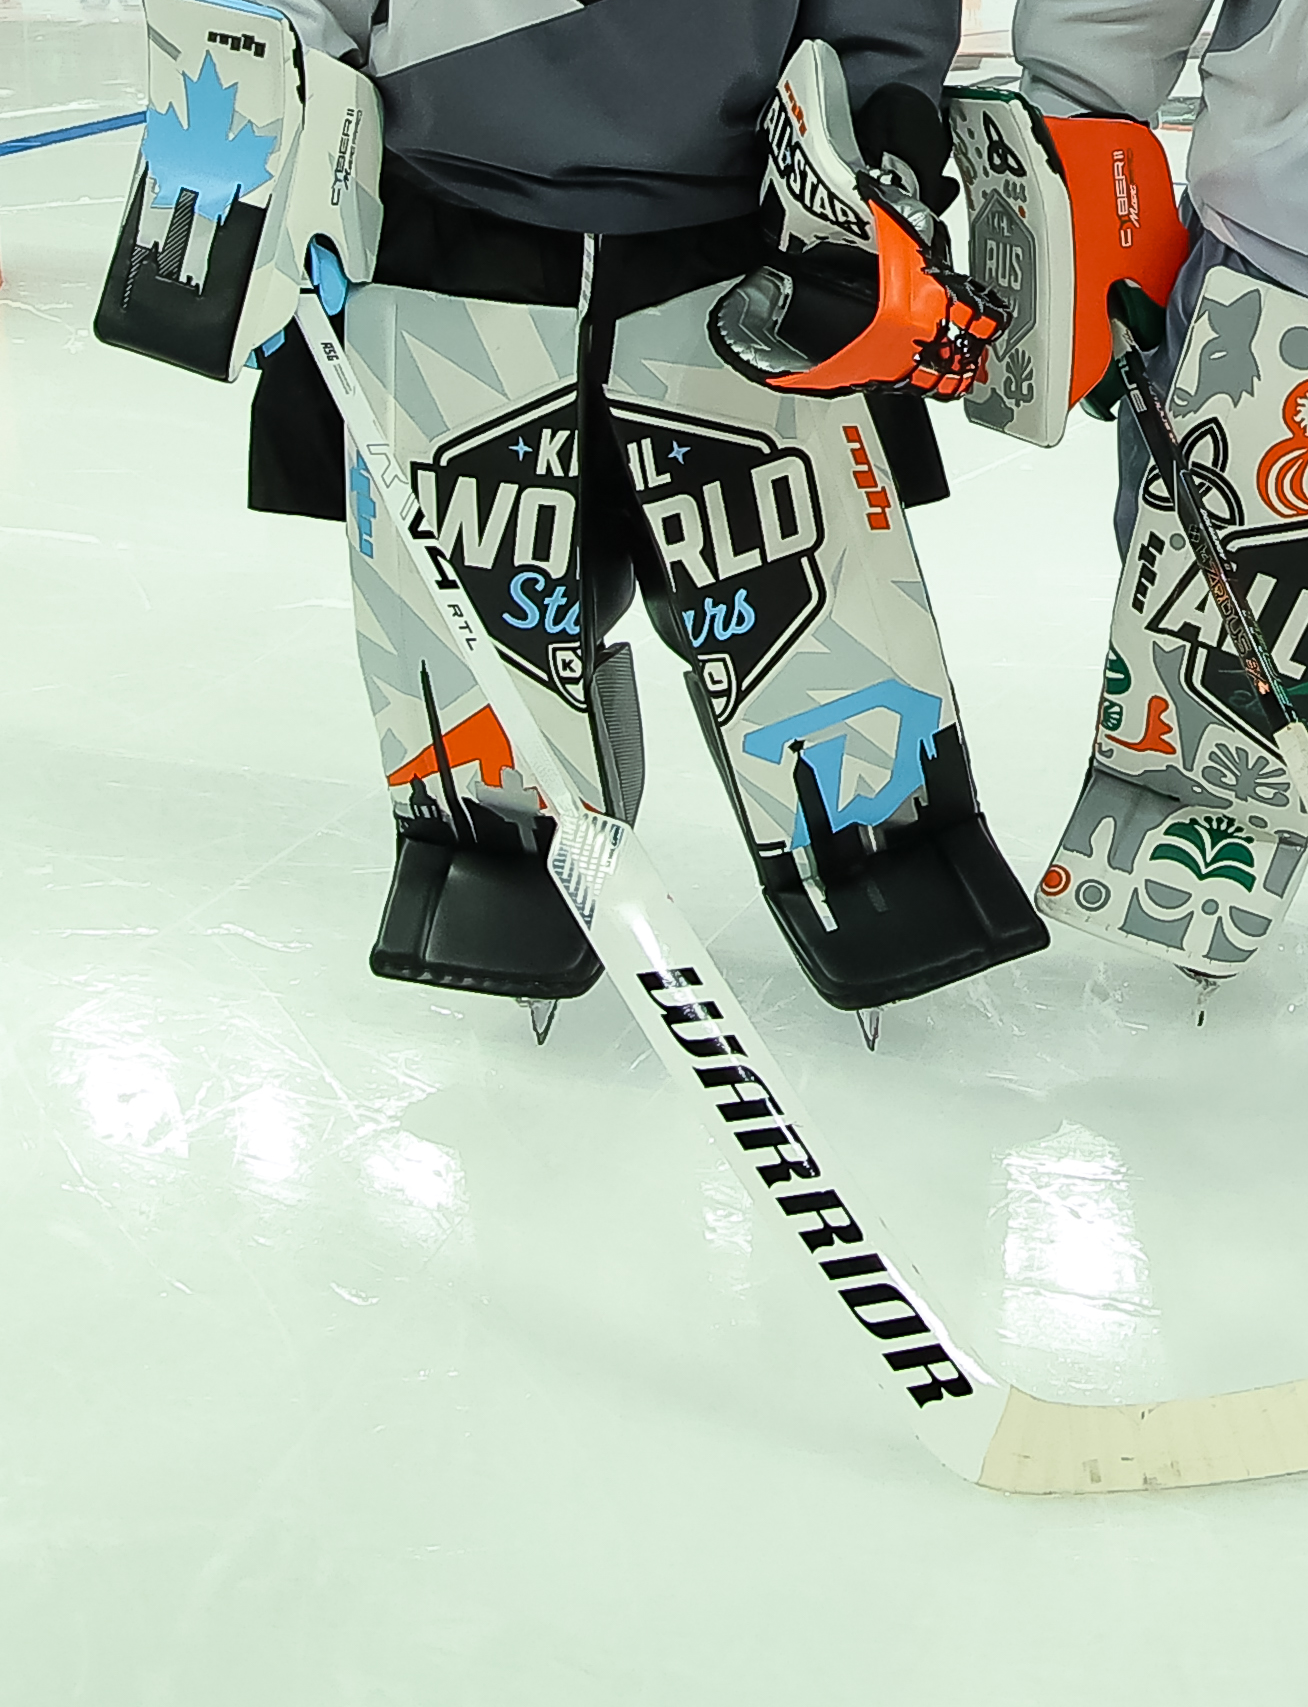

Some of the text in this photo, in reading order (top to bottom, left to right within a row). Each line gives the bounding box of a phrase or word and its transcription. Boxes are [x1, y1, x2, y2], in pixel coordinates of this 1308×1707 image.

[331, 117, 353, 206] CYBER
[764, 95, 863, 235] ALL STAR
[642, 455, 819, 591] RLD
[447, 603, 478, 651] RTL
[636, 965, 974, 1410] WARRIOR
